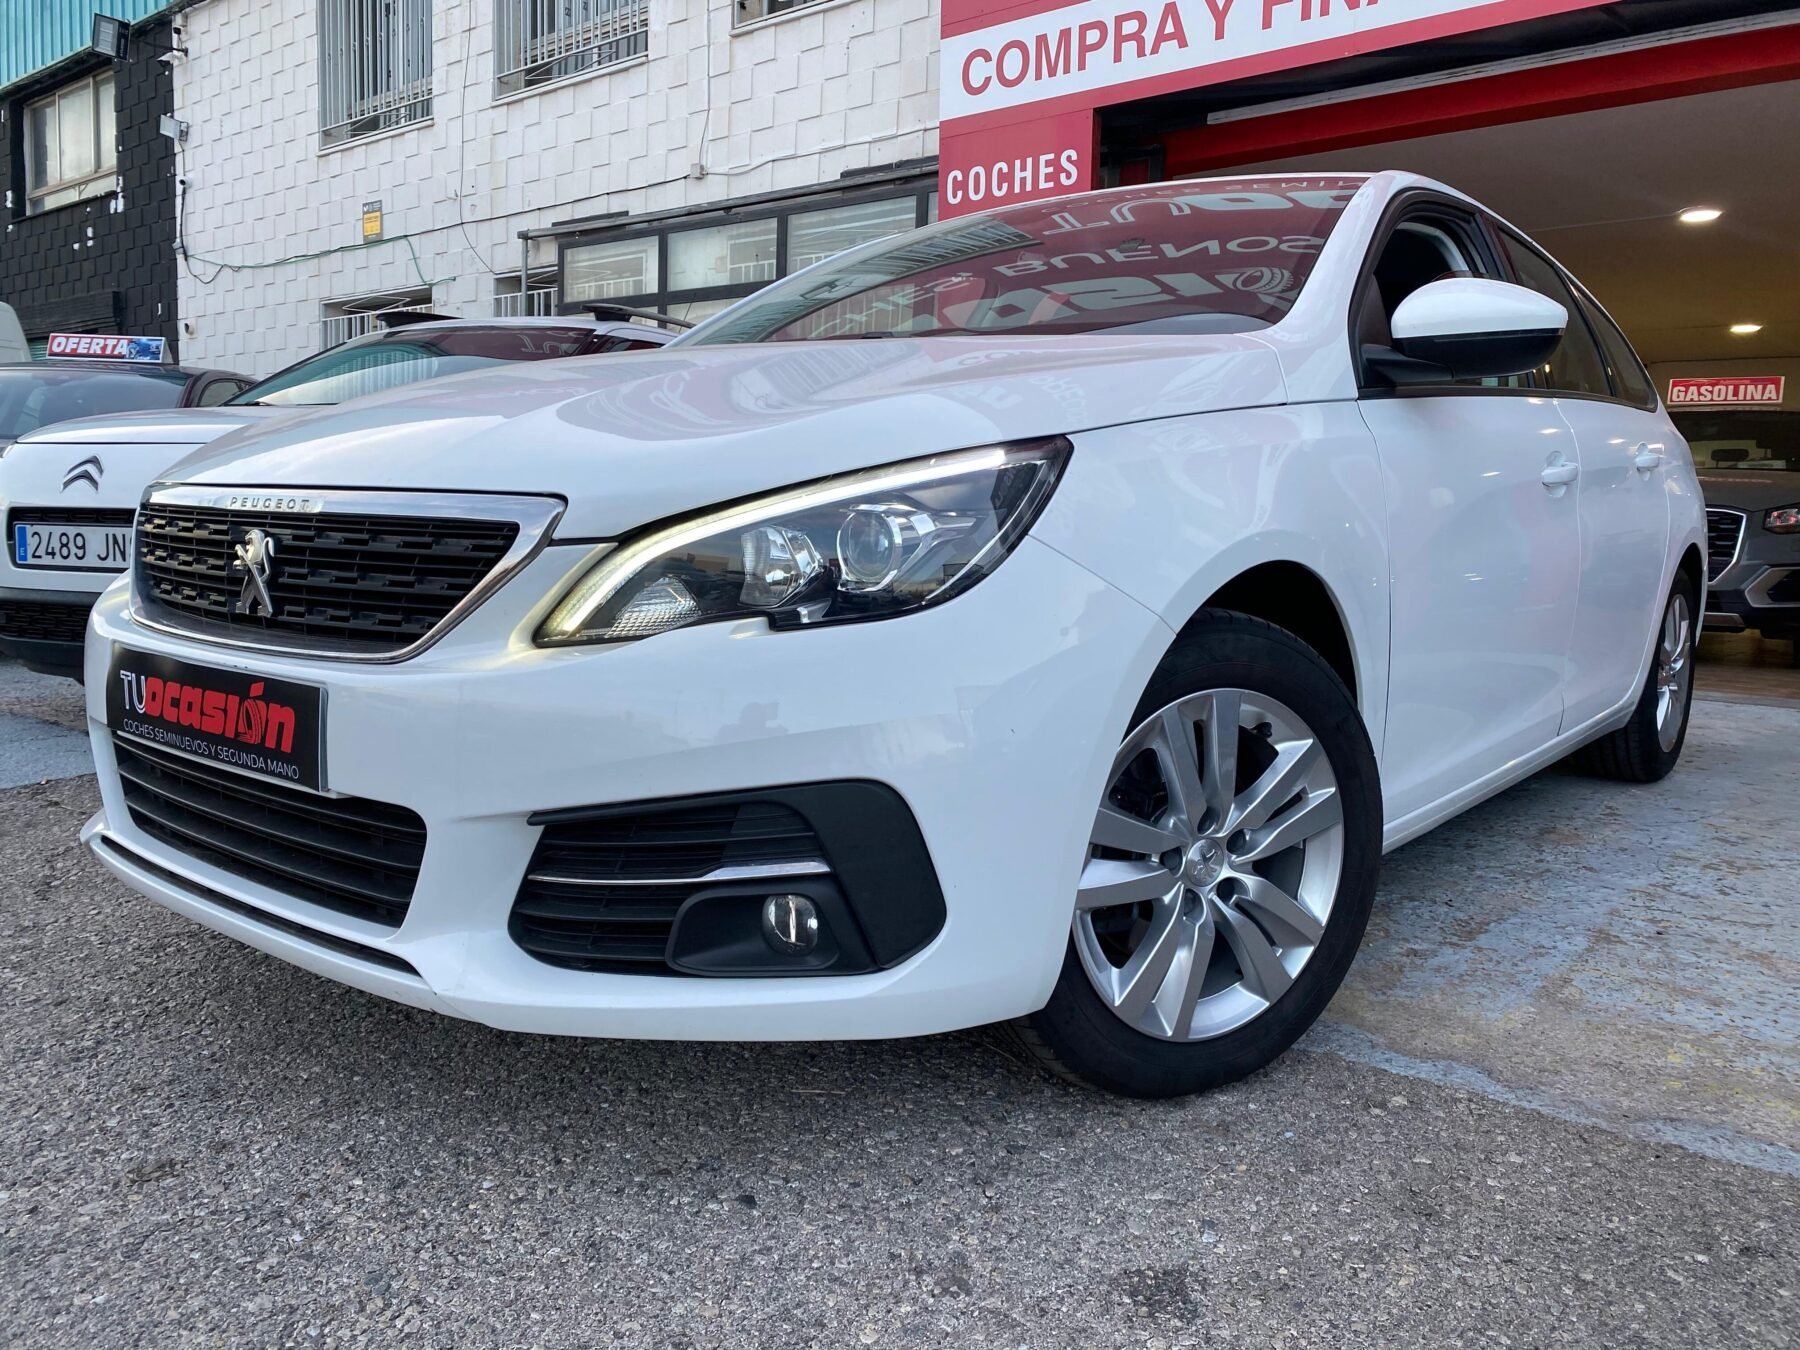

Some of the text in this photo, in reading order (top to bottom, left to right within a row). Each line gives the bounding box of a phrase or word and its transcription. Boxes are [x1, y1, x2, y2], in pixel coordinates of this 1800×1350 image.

[961, 1, 1189, 96] COMPRA
[1205, 0, 1234, 41] Y
[946, 148, 1079, 205] COCHES
[51, 336, 128, 355] OFERTA
[1671, 384, 1778, 402] GASOLINA
[230, 496, 310, 511] PEUGEOT
[31, 531, 87, 561] 2489
[97, 532, 133, 562] JN
[123, 718, 300, 780] COCHES SEMINUEVOS Y SEGUNDA MANO
